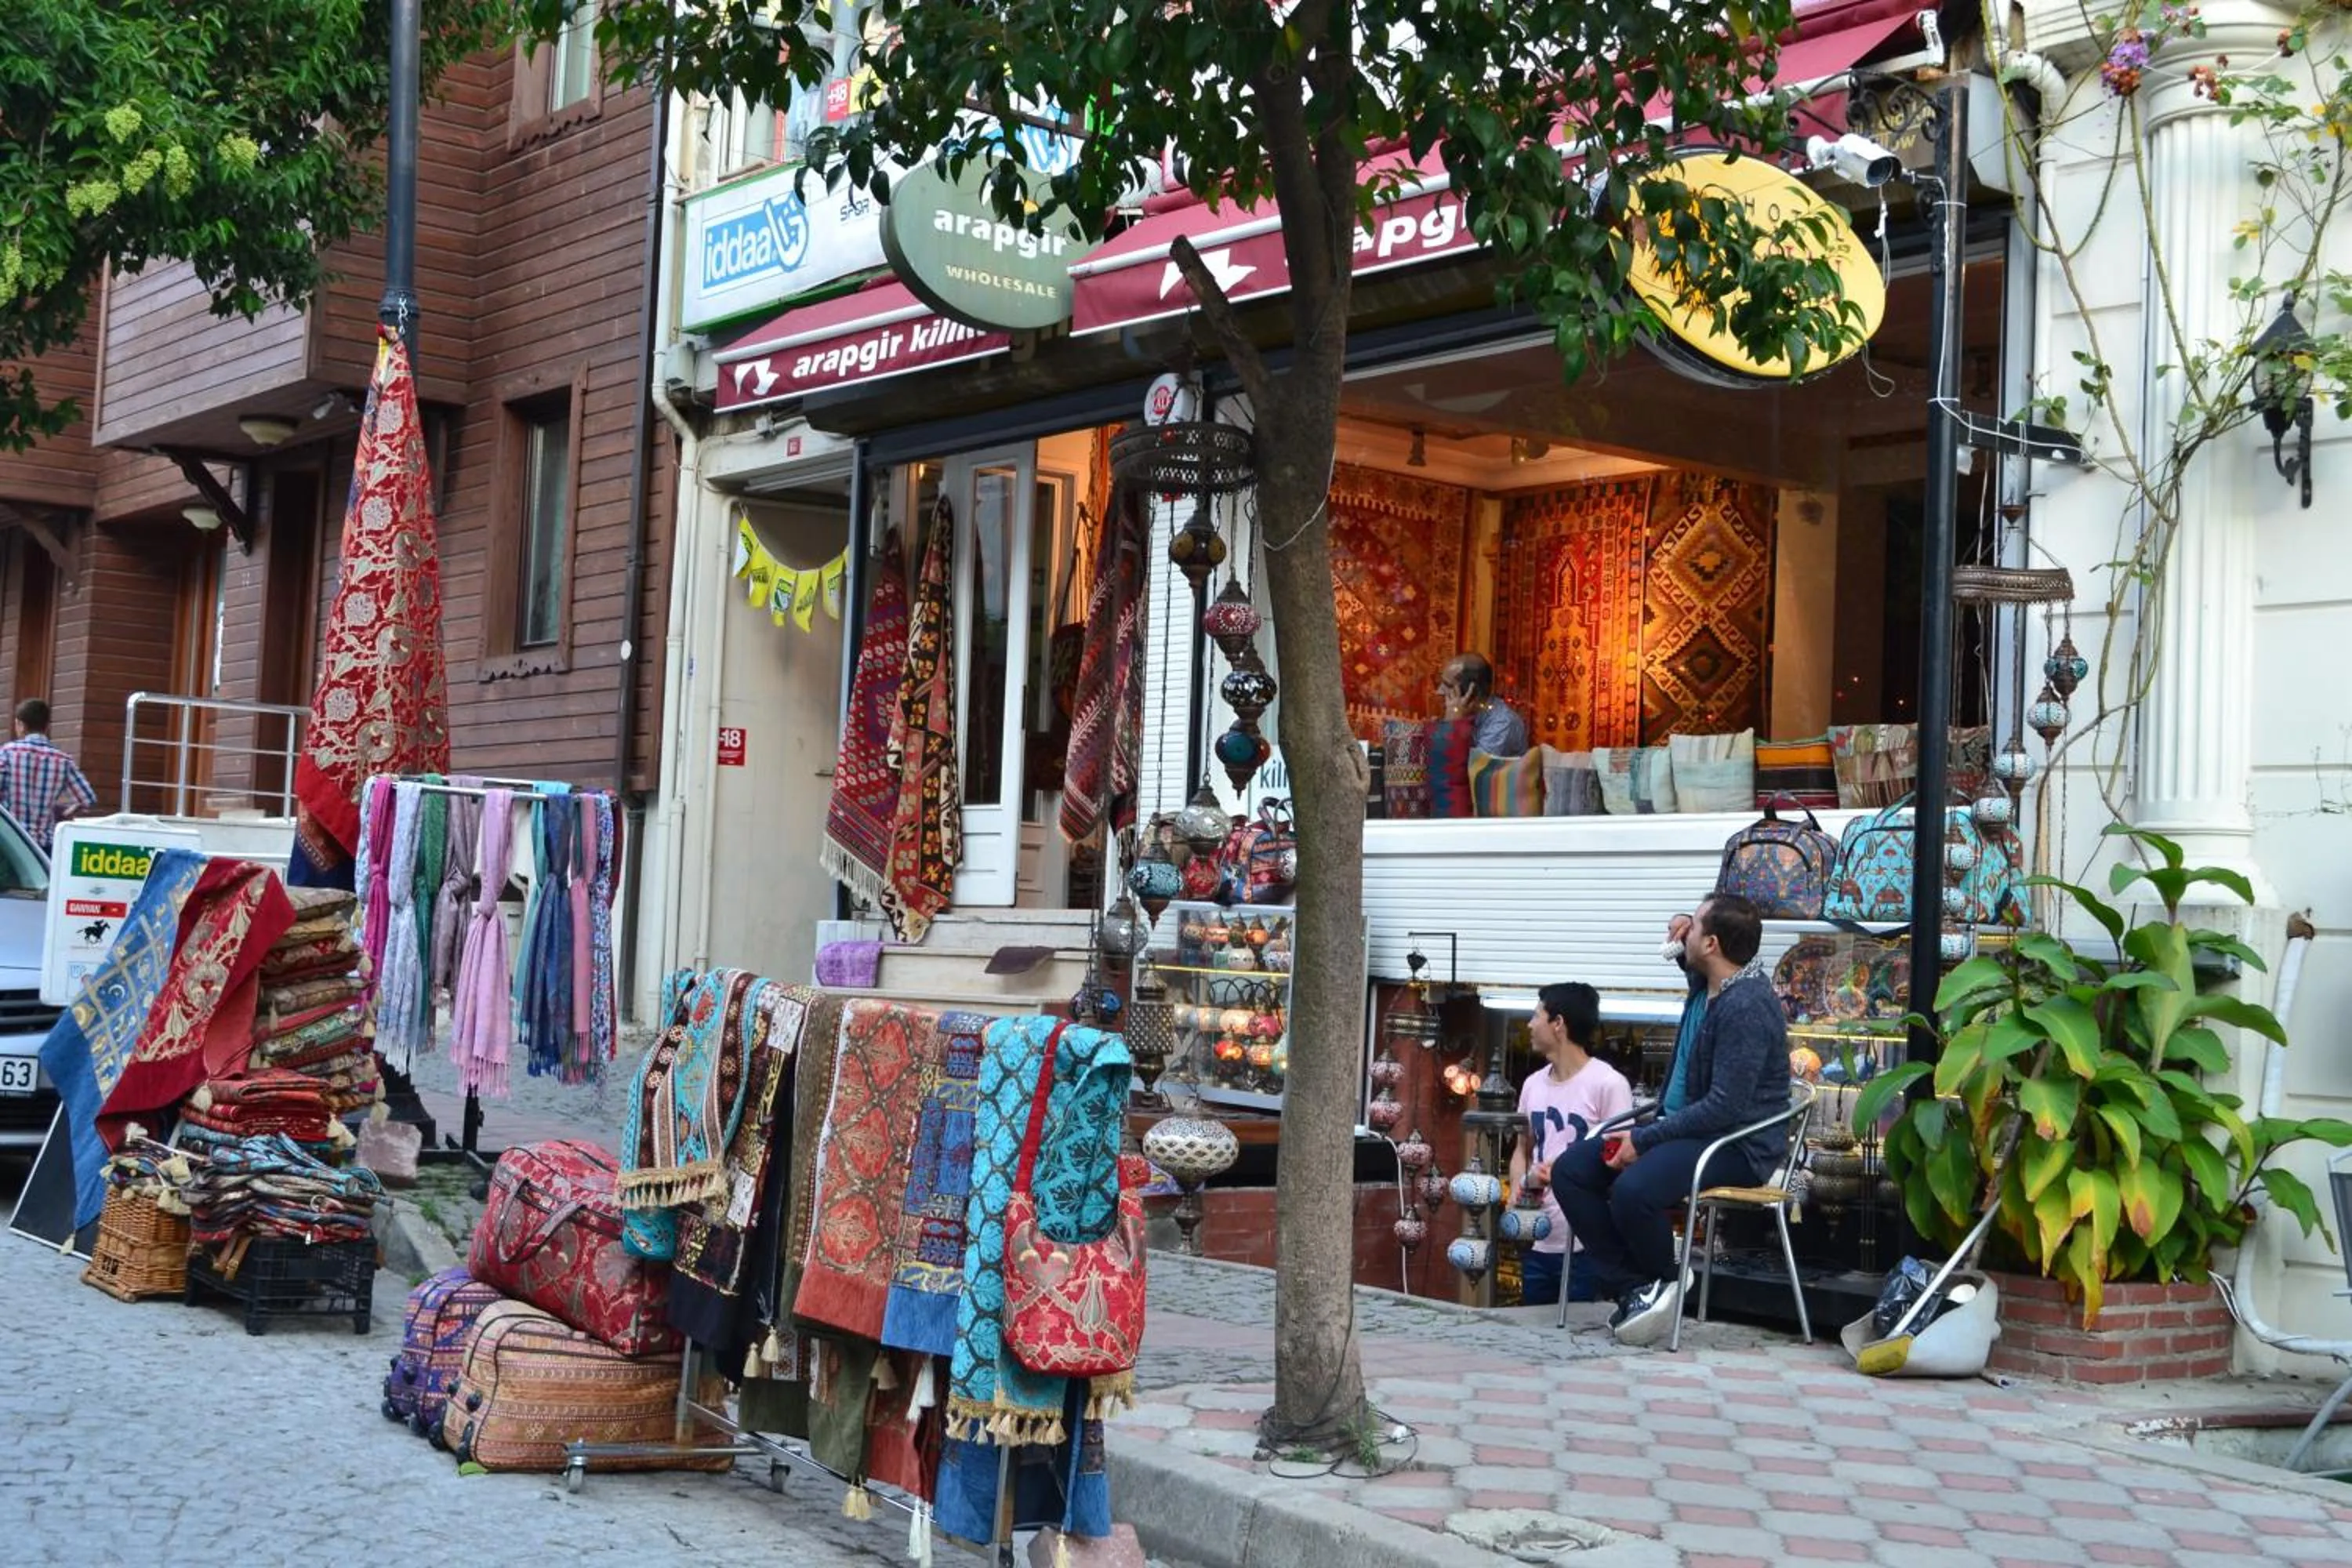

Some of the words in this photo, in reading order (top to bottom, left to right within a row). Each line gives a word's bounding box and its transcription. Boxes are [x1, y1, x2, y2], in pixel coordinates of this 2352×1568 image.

[706, 223, 772, 282] iddaa
[934, 209, 1068, 259] arapgir
[946, 264, 1057, 298] WHOLESALE
[792, 330, 903, 377] arapgir
[81, 847, 151, 877] iddaa
[2, 1061, 31, 1087] 63
